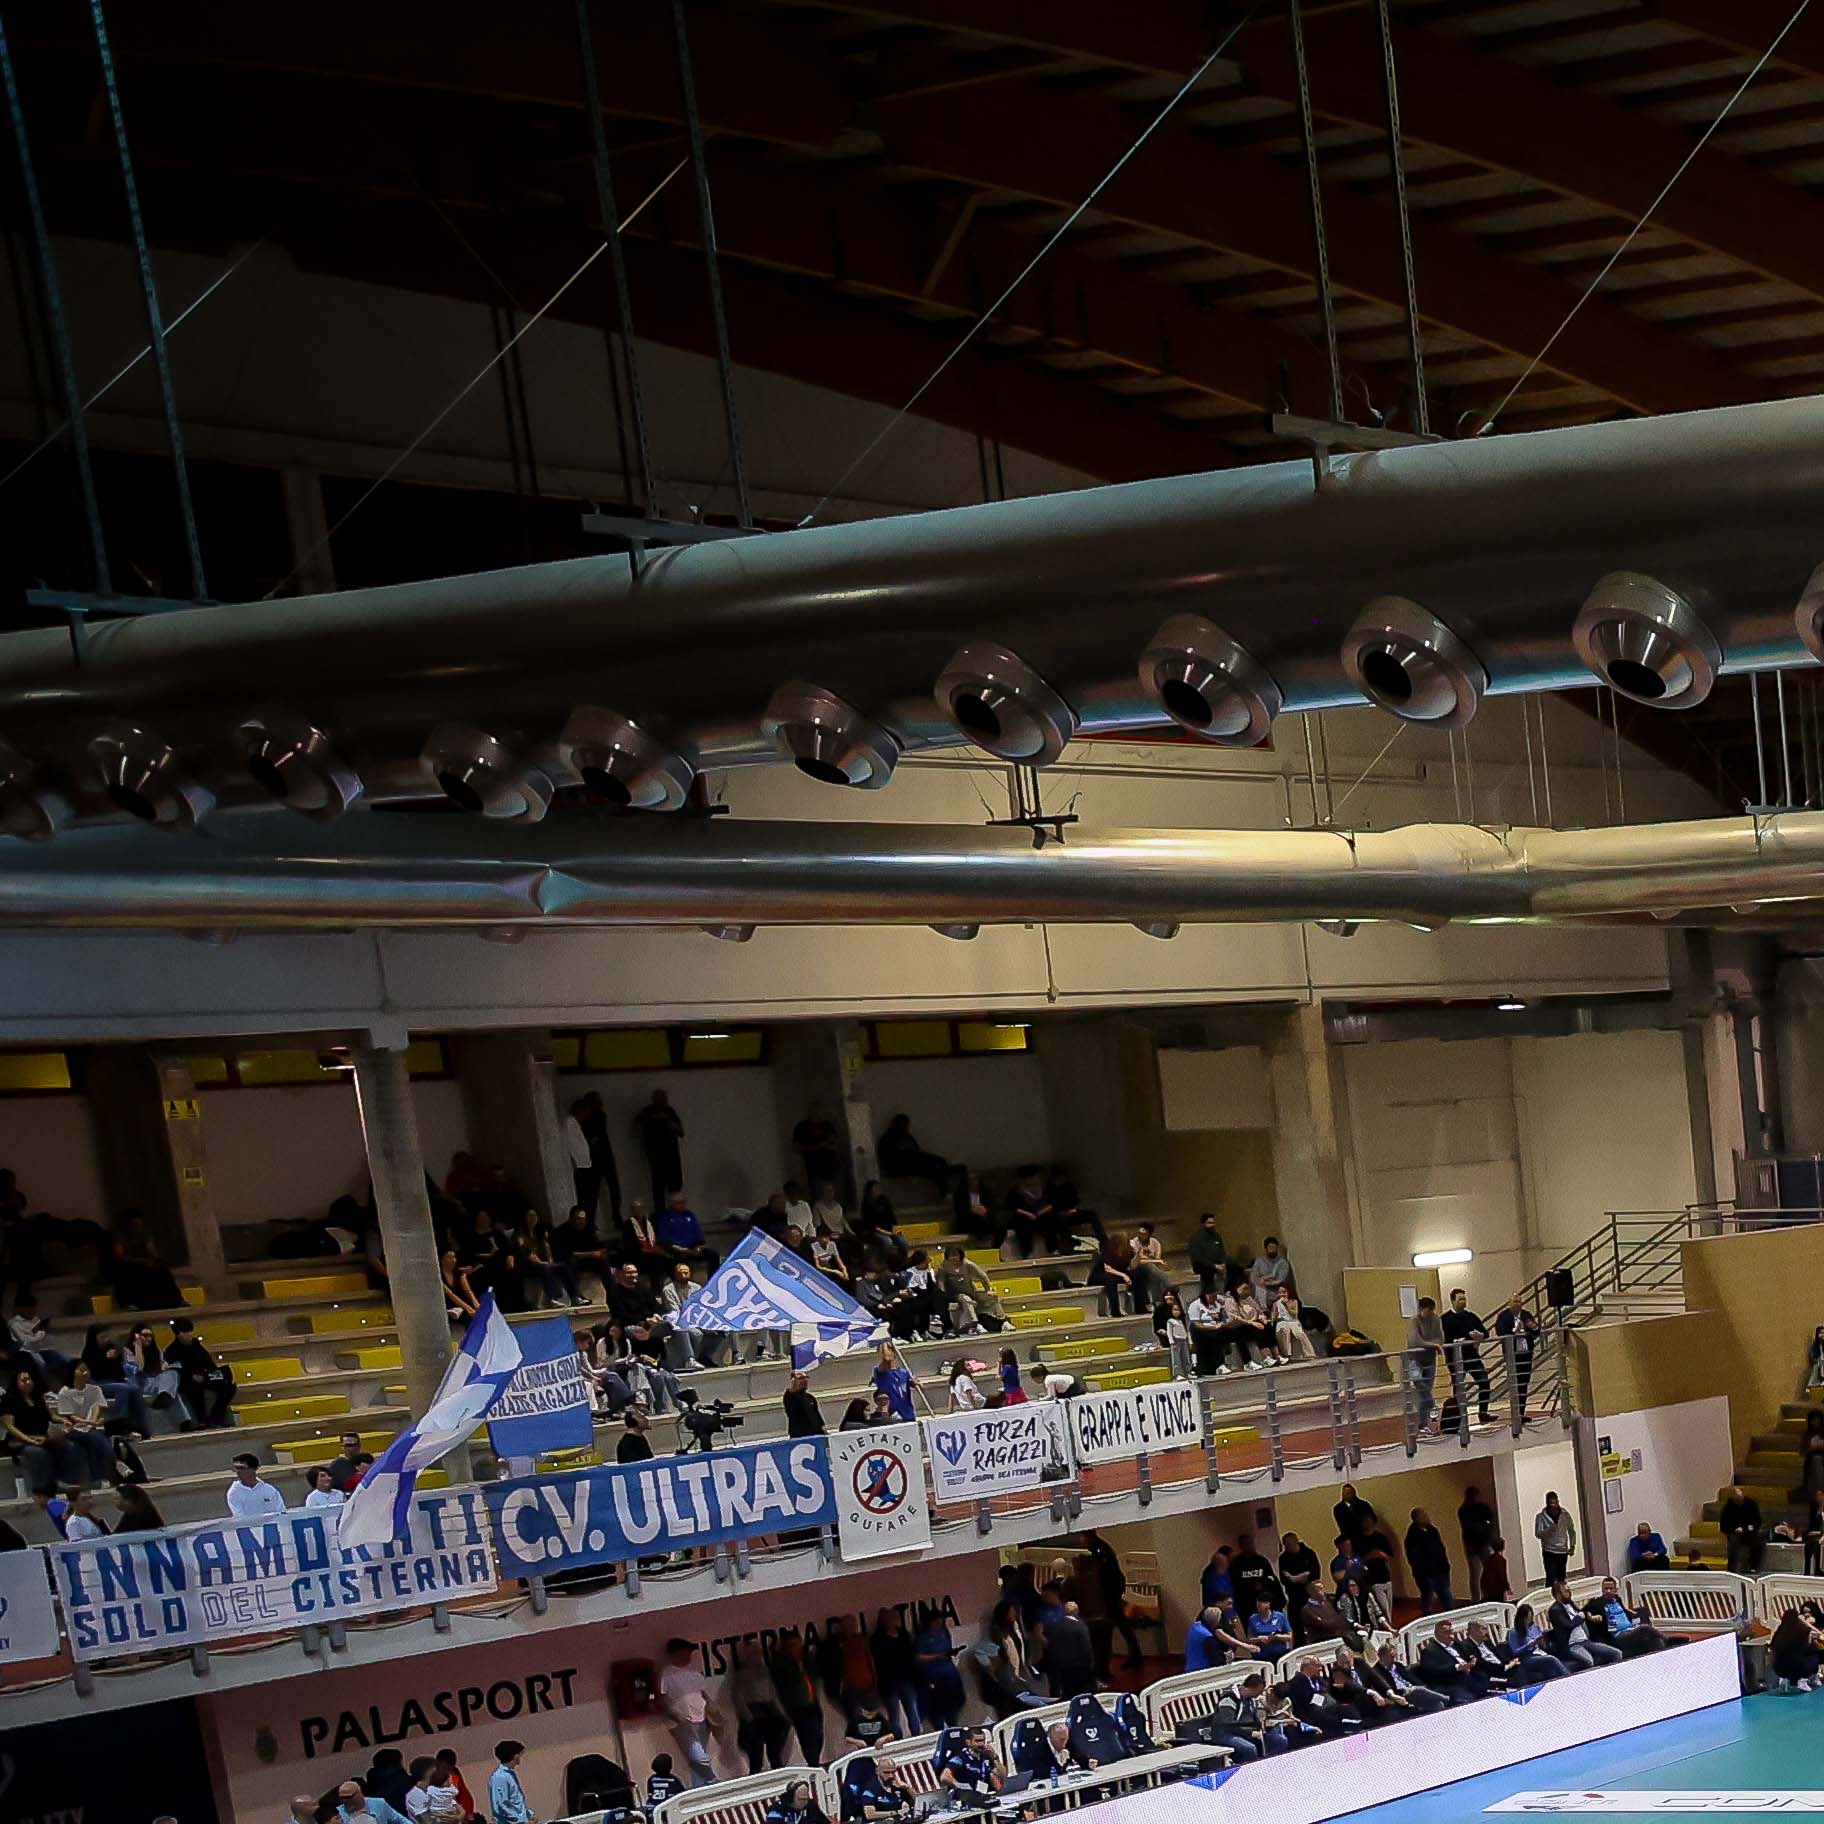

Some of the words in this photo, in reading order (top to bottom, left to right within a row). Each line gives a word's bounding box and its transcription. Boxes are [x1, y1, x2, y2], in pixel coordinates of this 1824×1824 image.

[974, 1417, 1036, 1444] FORZA
[1078, 1403, 1135, 1452] GRAPPA
[1136, 1394, 1150, 1443] E
[1149, 1390, 1196, 1440] VINCI
[839, 1433, 912, 1462] VIETATO
[972, 1439, 1046, 1471] RAGAZZI
[501, 1480, 605, 1563] C.V.
[611, 1444, 825, 1544] ULTRAS
[849, 1504, 919, 1533] GUFARE
[73, 1597, 187, 1649] SOLO
[203, 1584, 278, 1627] DEL
[292, 1548, 490, 1613] CISTERNA
[301, 1667, 577, 1758] PALASPORT
